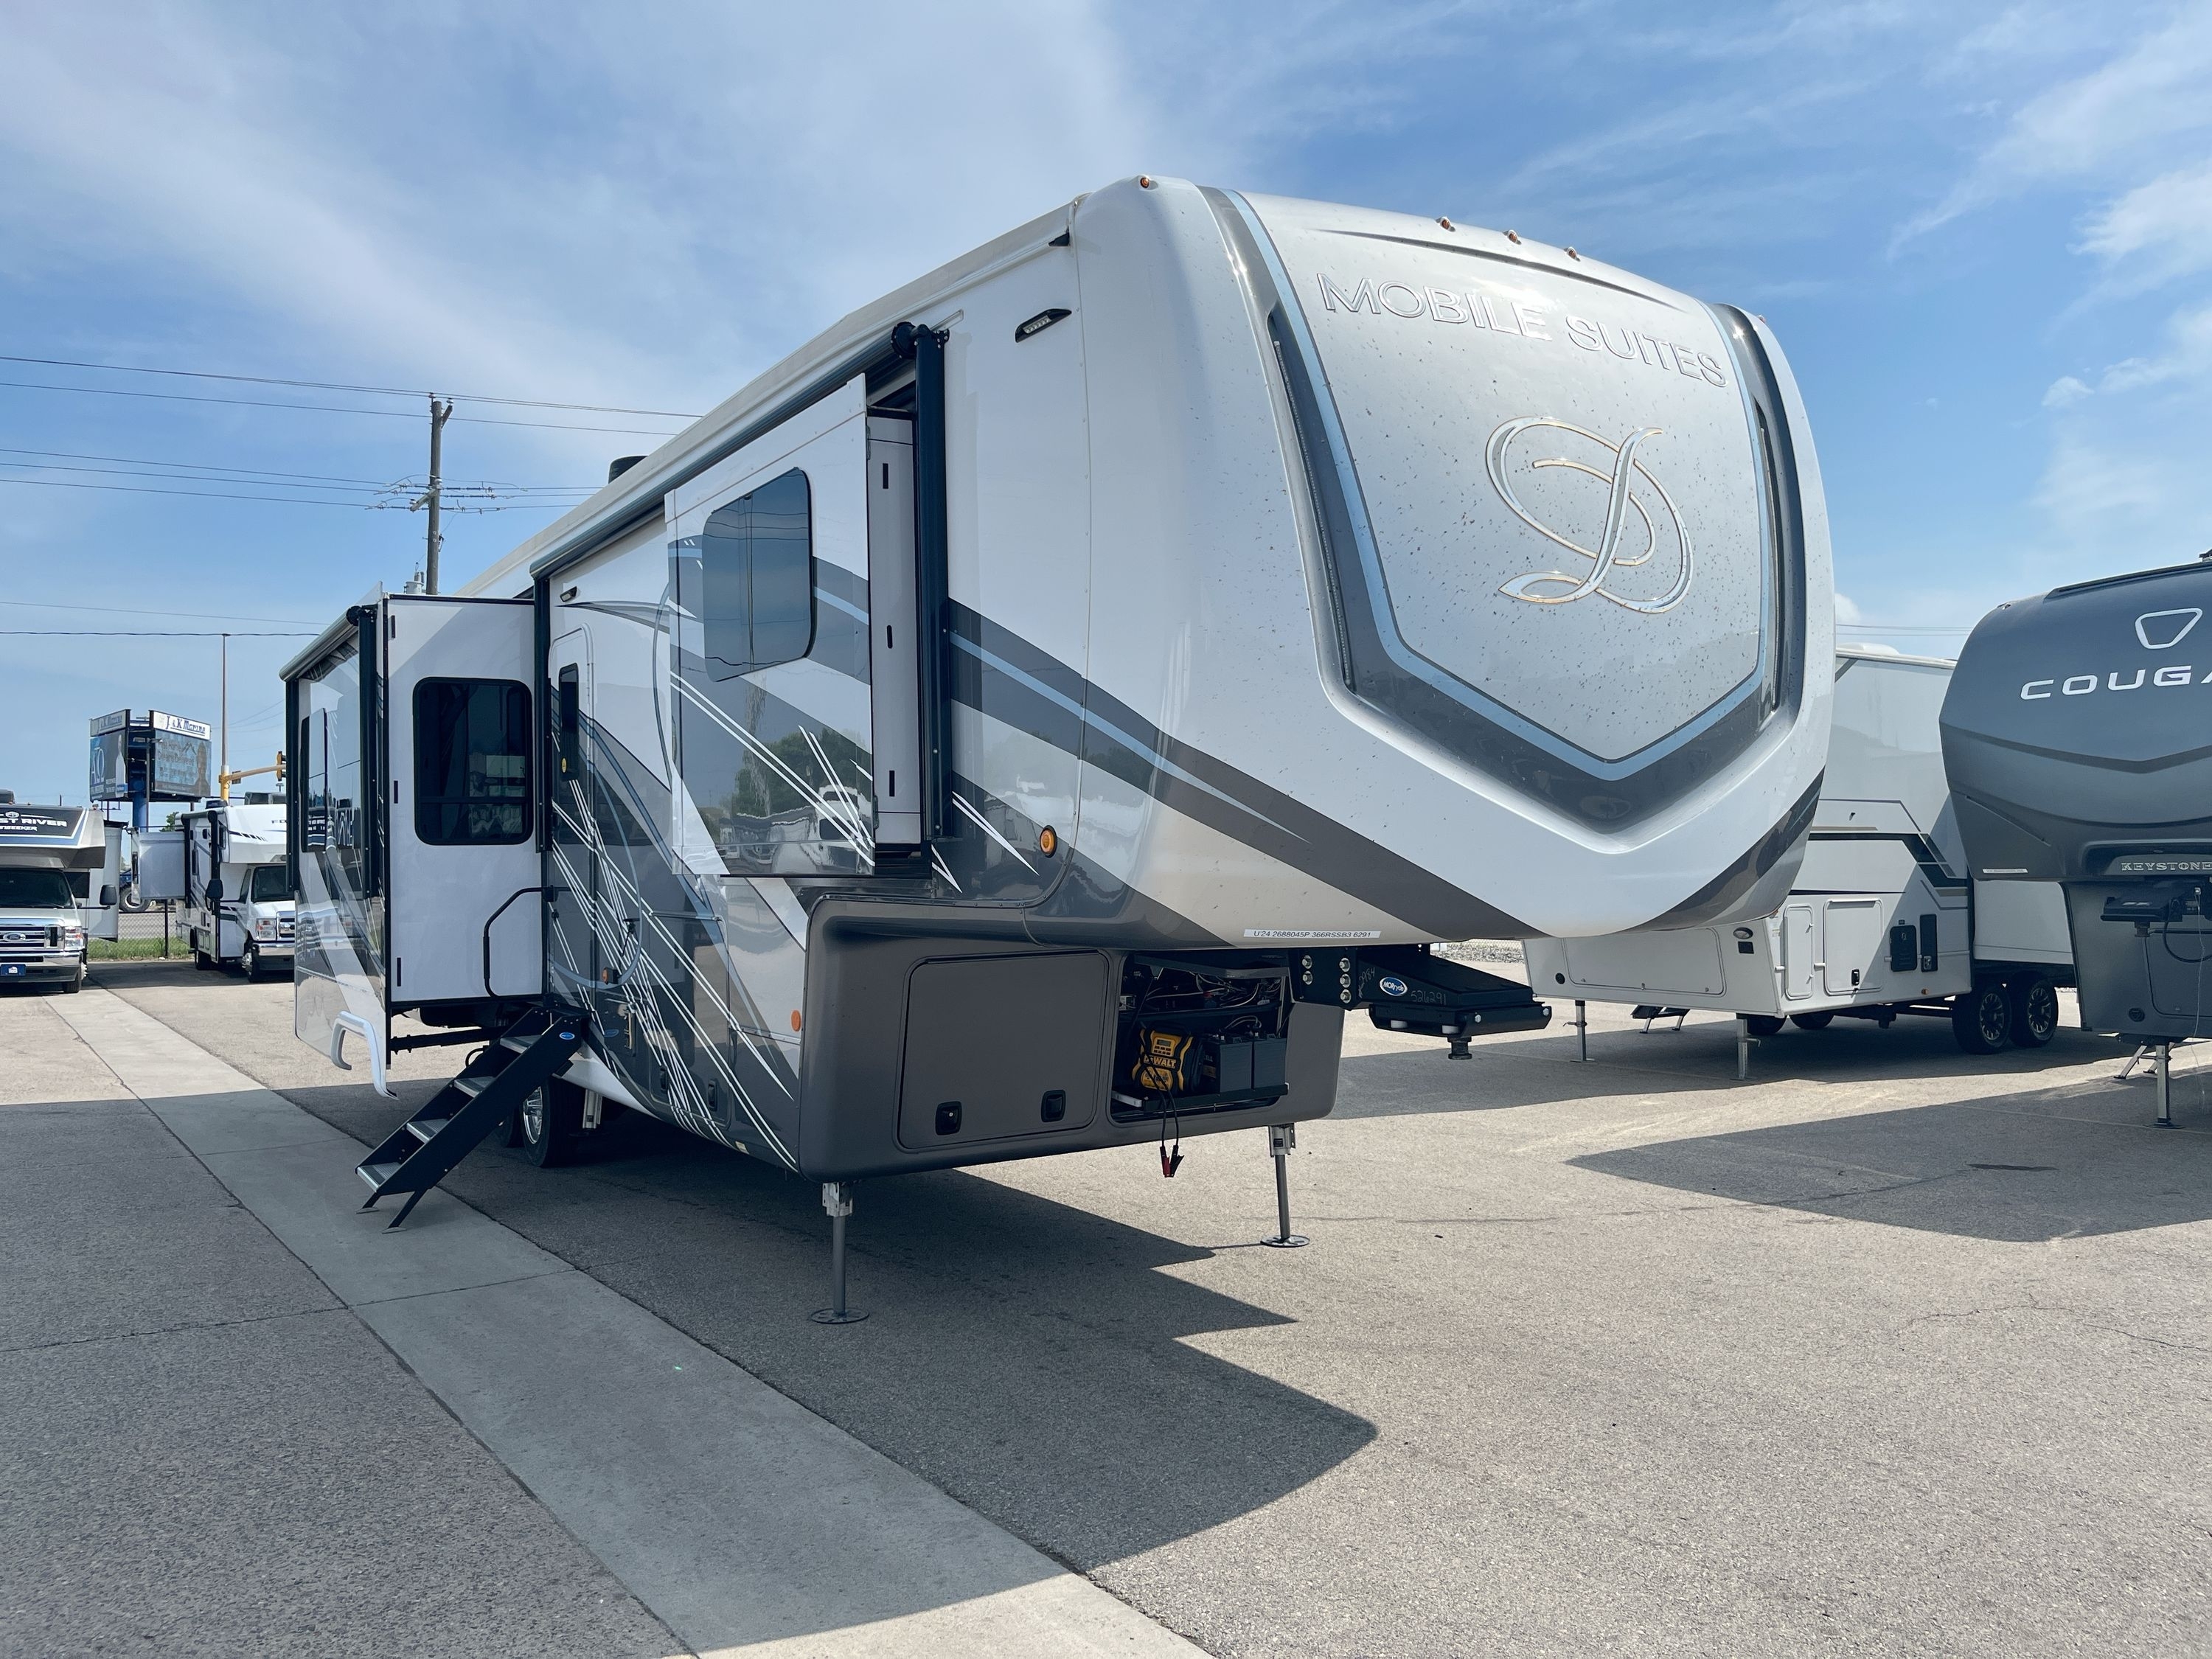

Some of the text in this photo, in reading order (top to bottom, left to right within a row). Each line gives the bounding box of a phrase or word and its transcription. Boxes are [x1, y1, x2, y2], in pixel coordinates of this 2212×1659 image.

[1317, 273, 1728, 387] MOBILE SUITES
[2020, 665, 2212, 700] COUG
[176, 718, 182, 728] K
[183, 720, 206, 734] Marine
[21, 818, 67, 827] RIVER
[2121, 862, 2212, 871] KEYSTONE
[1411, 990, 1447, 1005] 526291
[1144, 1054, 1176, 1068] DWALT
